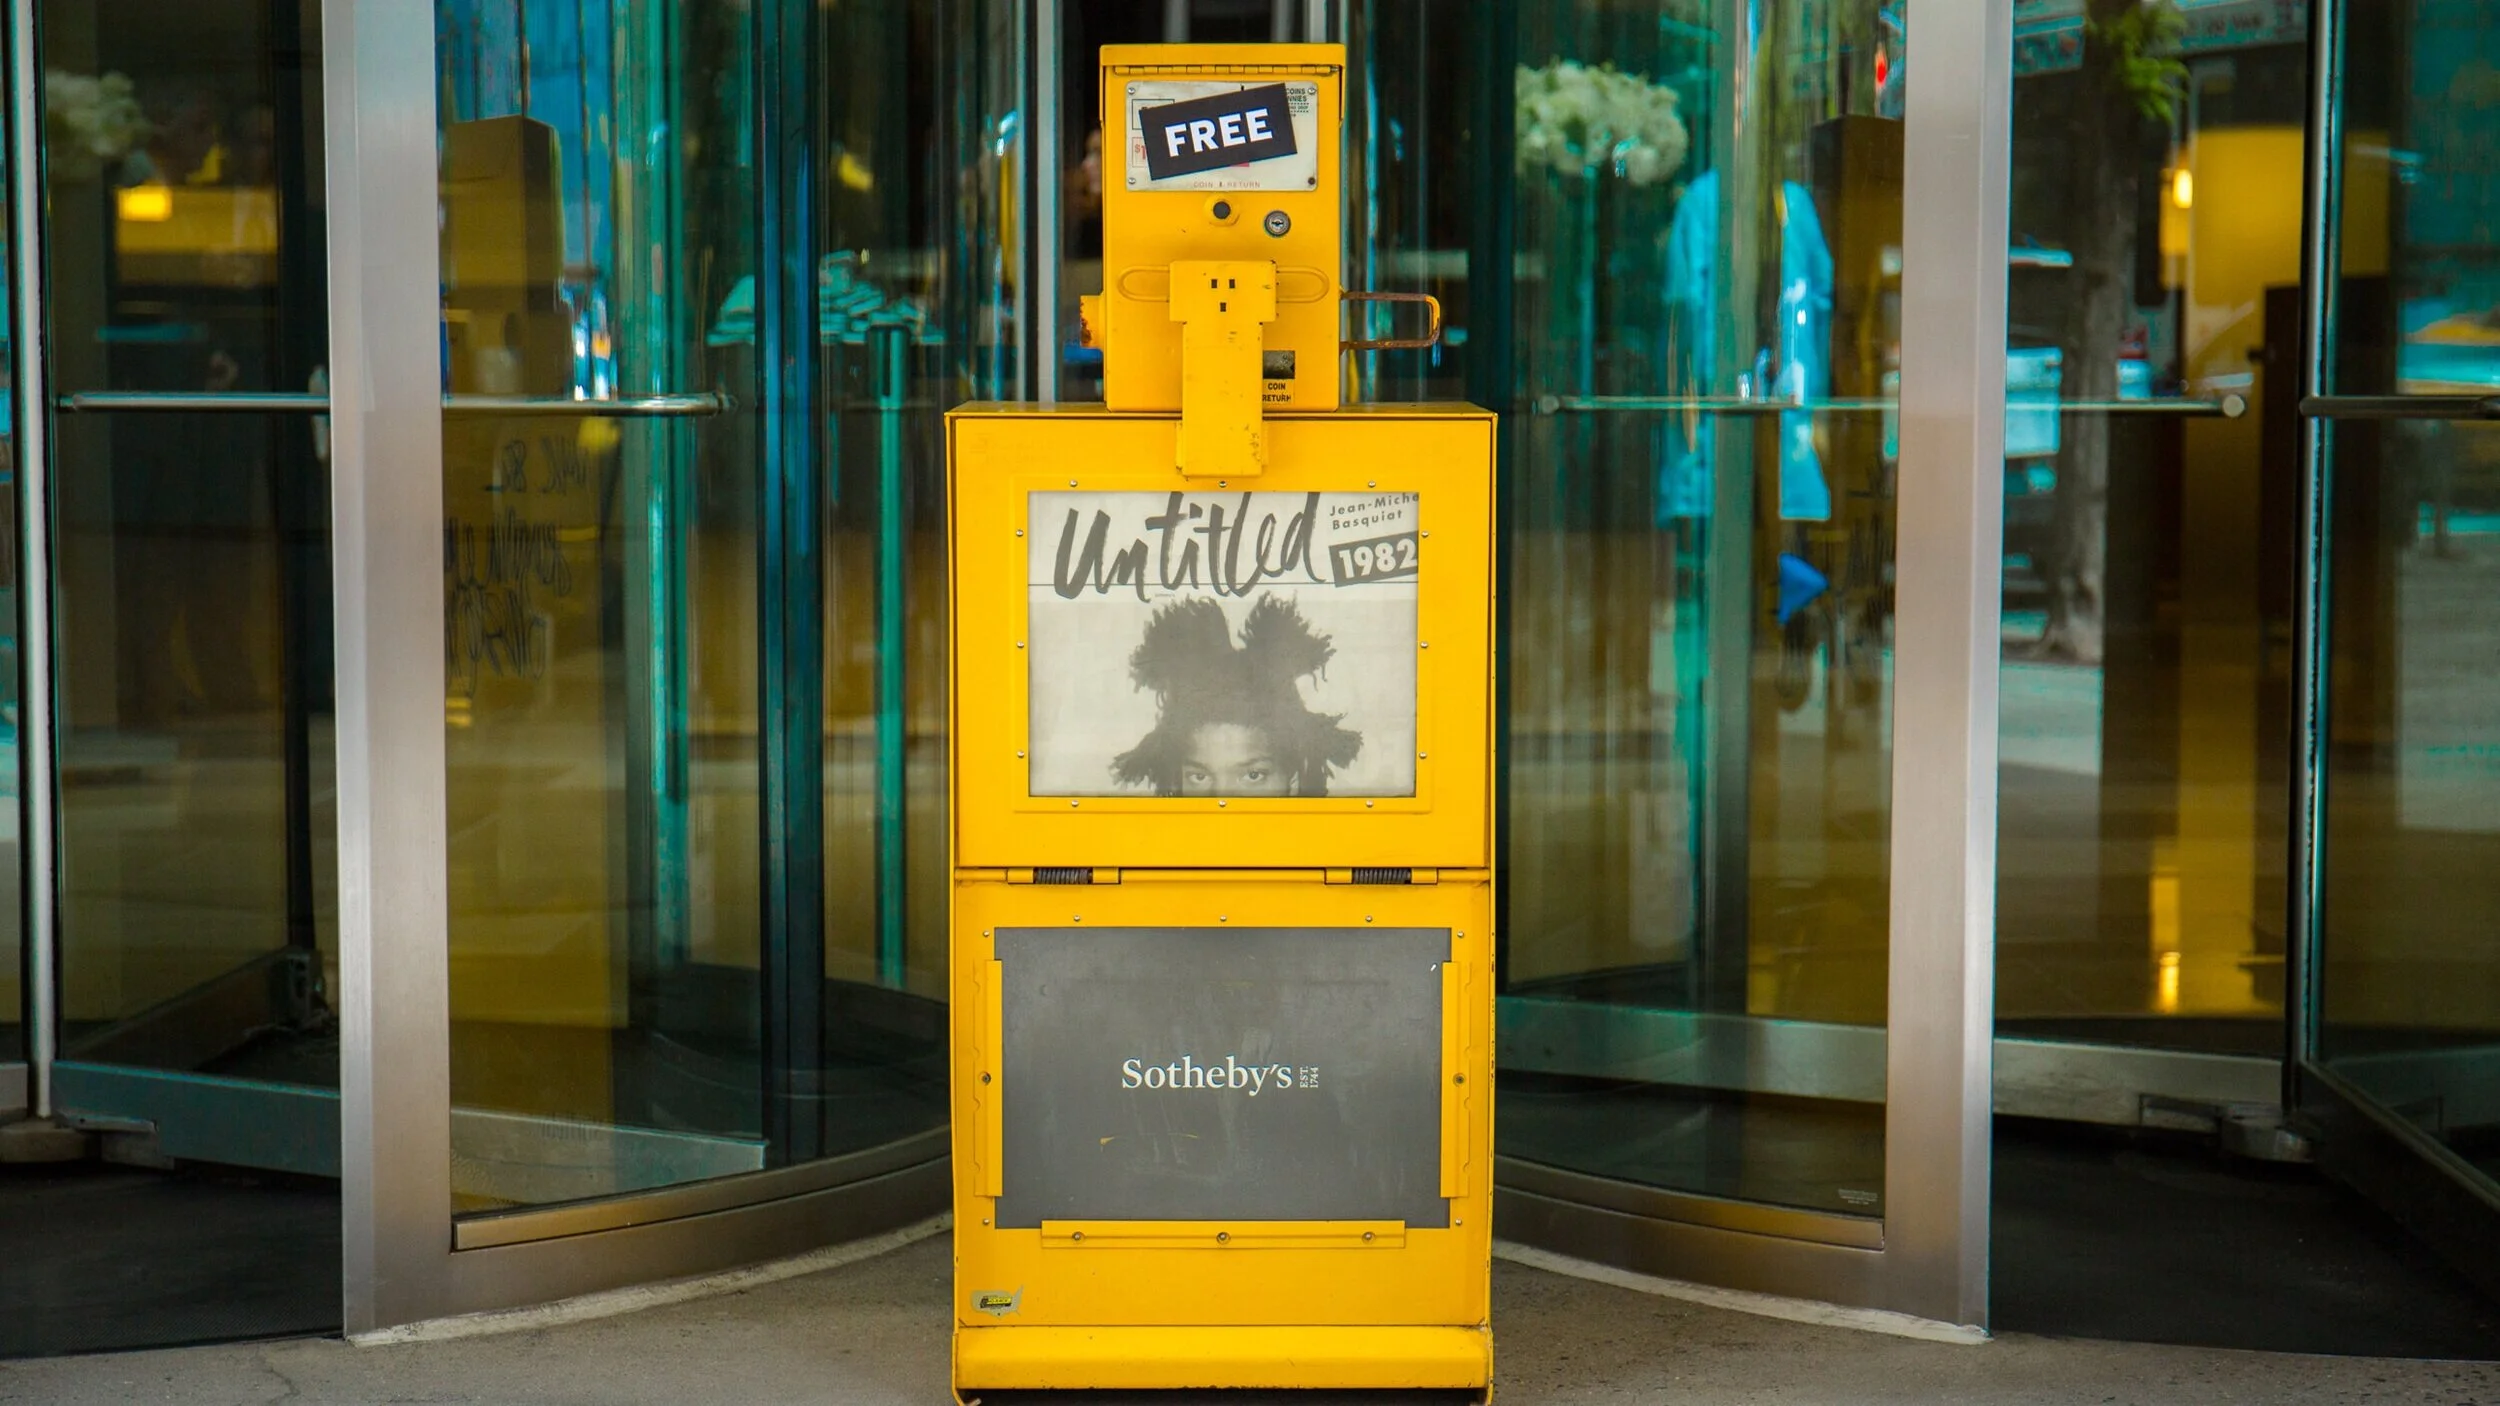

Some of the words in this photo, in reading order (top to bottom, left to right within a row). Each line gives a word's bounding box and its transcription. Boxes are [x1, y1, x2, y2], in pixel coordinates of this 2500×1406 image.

[1164, 107, 1273, 157] FREE
[1267, 382, 1286, 391] COIN
[1332, 509, 1402, 530] Basquiat
[1054, 492, 1327, 603] Untitled
[1338, 538, 1418, 579] 1982
[1121, 1055, 1293, 1097] Sotheby's
[1310, 1067, 1319, 1088] 1744
